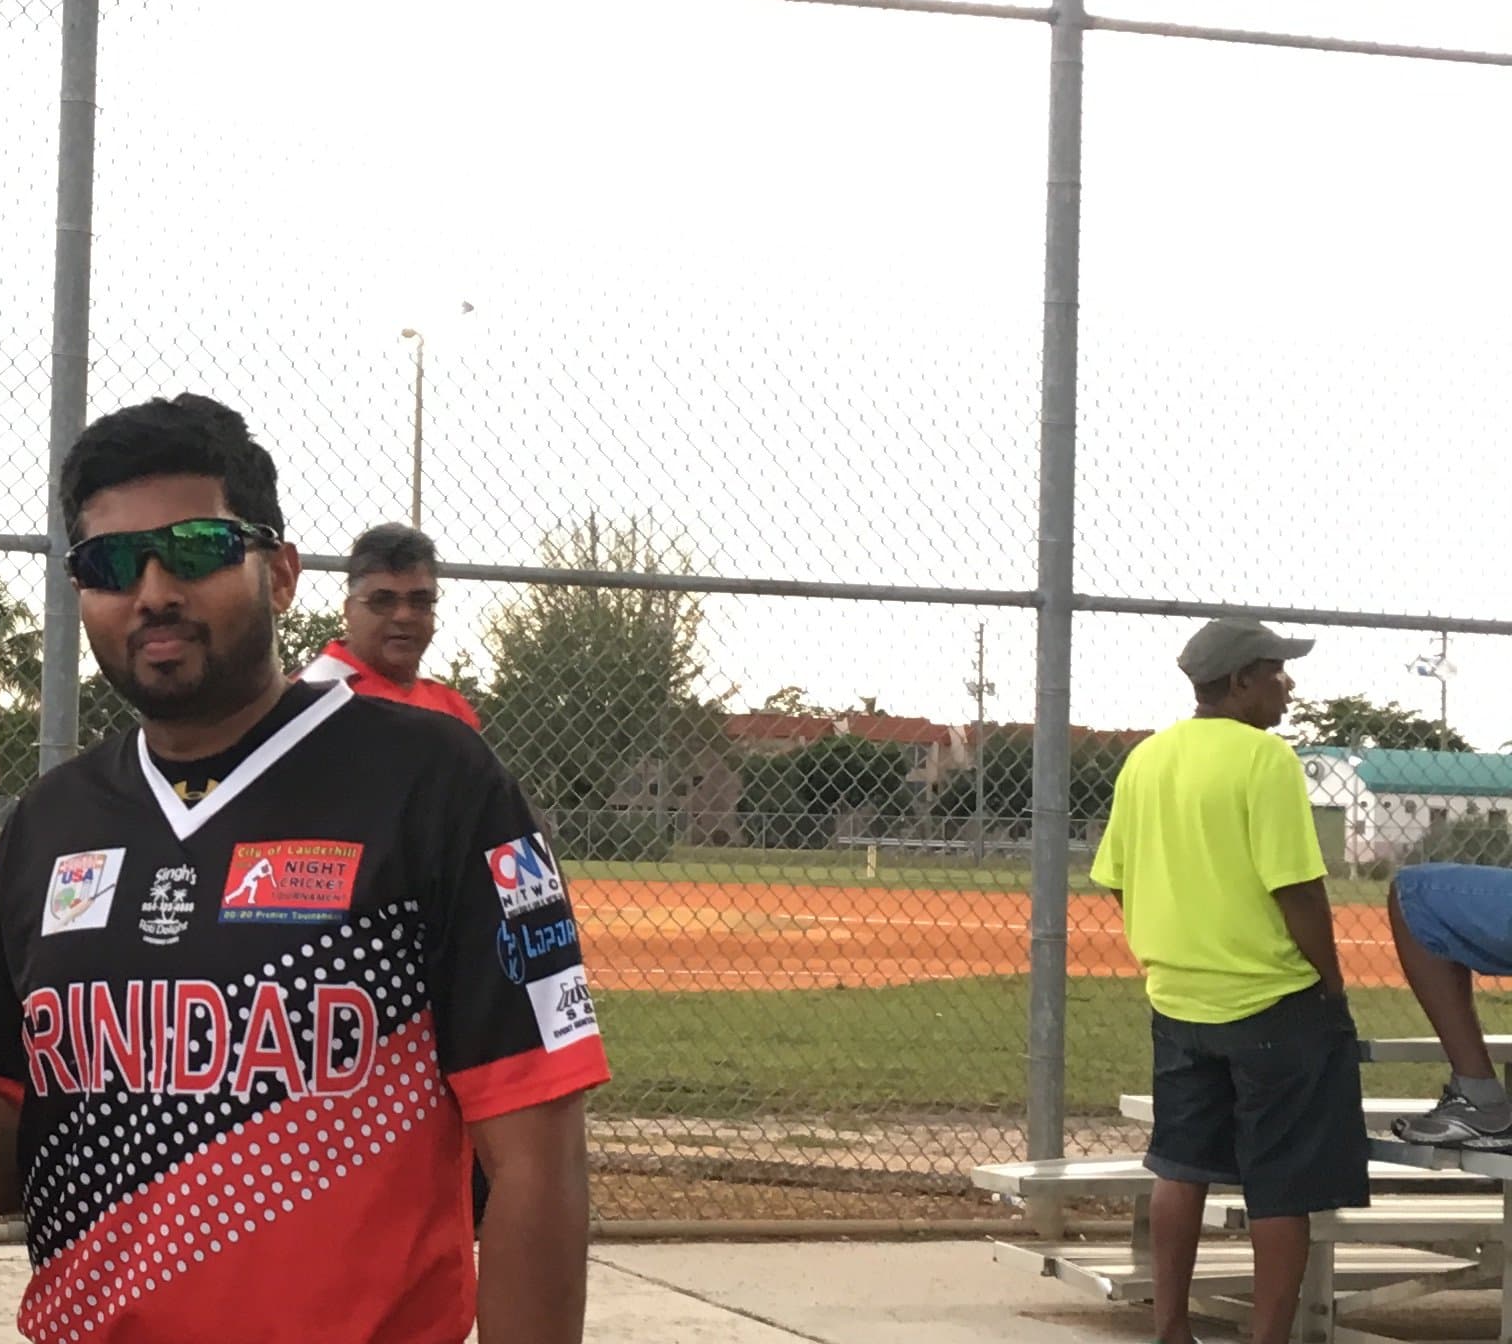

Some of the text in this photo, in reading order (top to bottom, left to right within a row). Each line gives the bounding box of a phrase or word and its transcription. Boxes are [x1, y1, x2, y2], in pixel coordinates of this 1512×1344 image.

[238, 845, 356, 858] City of Lauderhill
[285, 861, 347, 875] NIGHT
[62, 868, 93, 884] USA
[280, 876, 344, 890] CRICKET
[22, 979, 378, 1097] RINIDAD
